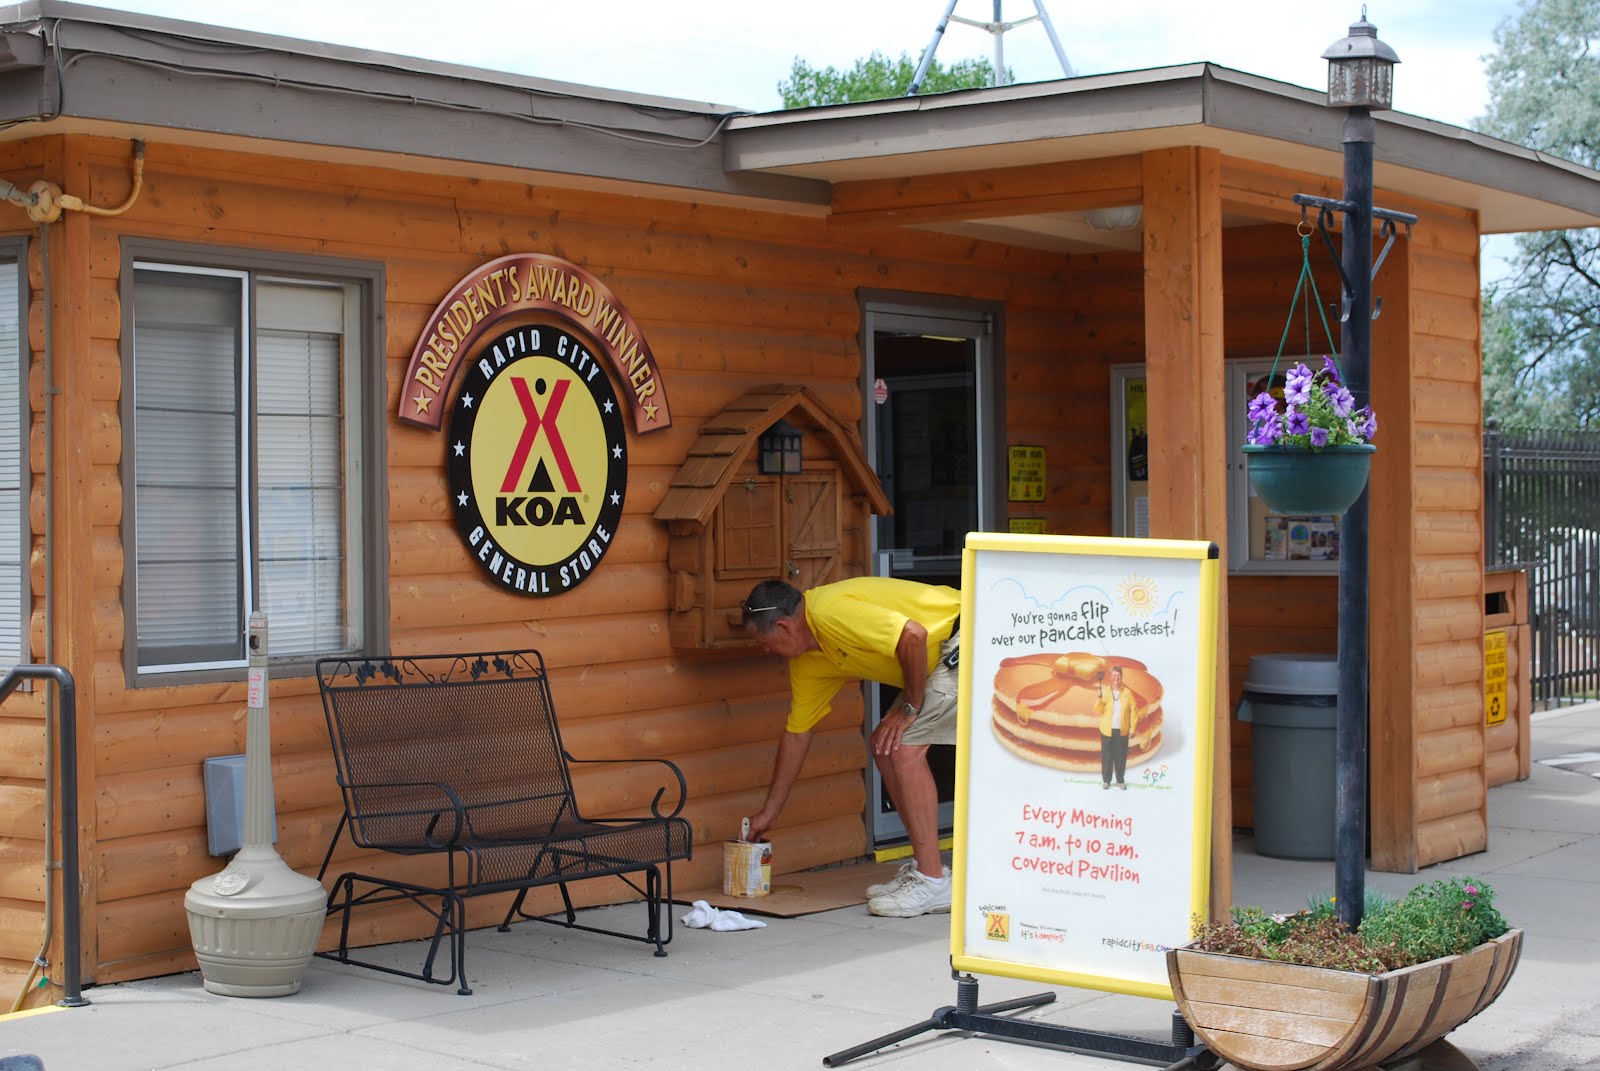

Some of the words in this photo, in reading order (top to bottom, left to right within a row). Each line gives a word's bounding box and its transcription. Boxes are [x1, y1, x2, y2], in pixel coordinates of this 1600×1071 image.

[414, 264, 522, 394] PRESIDENT'S
[525, 263, 595, 317] AWARD
[598, 295, 658, 405] WINNER
[478, 329, 541, 380] RAPID
[557, 335, 600, 383] CITY
[495, 496, 585, 527] KOA
[469, 525, 550, 593] GENERAL
[560, 525, 610, 588] STORE
[991, 635, 1014, 647] over
[1018, 633, 1036, 644] our
[1039, 622, 1106, 648] pancake
[1110, 608, 1178, 638] breakfast!
[1011, 611, 1044, 627] You're
[1047, 609, 1078, 626] gonna
[1081, 600, 1109, 623] flip
[1023, 804, 1066, 828] Every
[1071, 808, 1133, 836] Morning
[1015, 831, 1025, 845] 7
[1029, 835, 1061, 850] a.m.
[1065, 834, 1082, 856] to
[1086, 839, 1101, 854] 10
[1106, 842, 1139, 858] a.m.
[1012, 856, 1073, 876] Covered
[1078, 860, 1141, 884] Pavilion
[1021, 930, 1034, 940] It's
